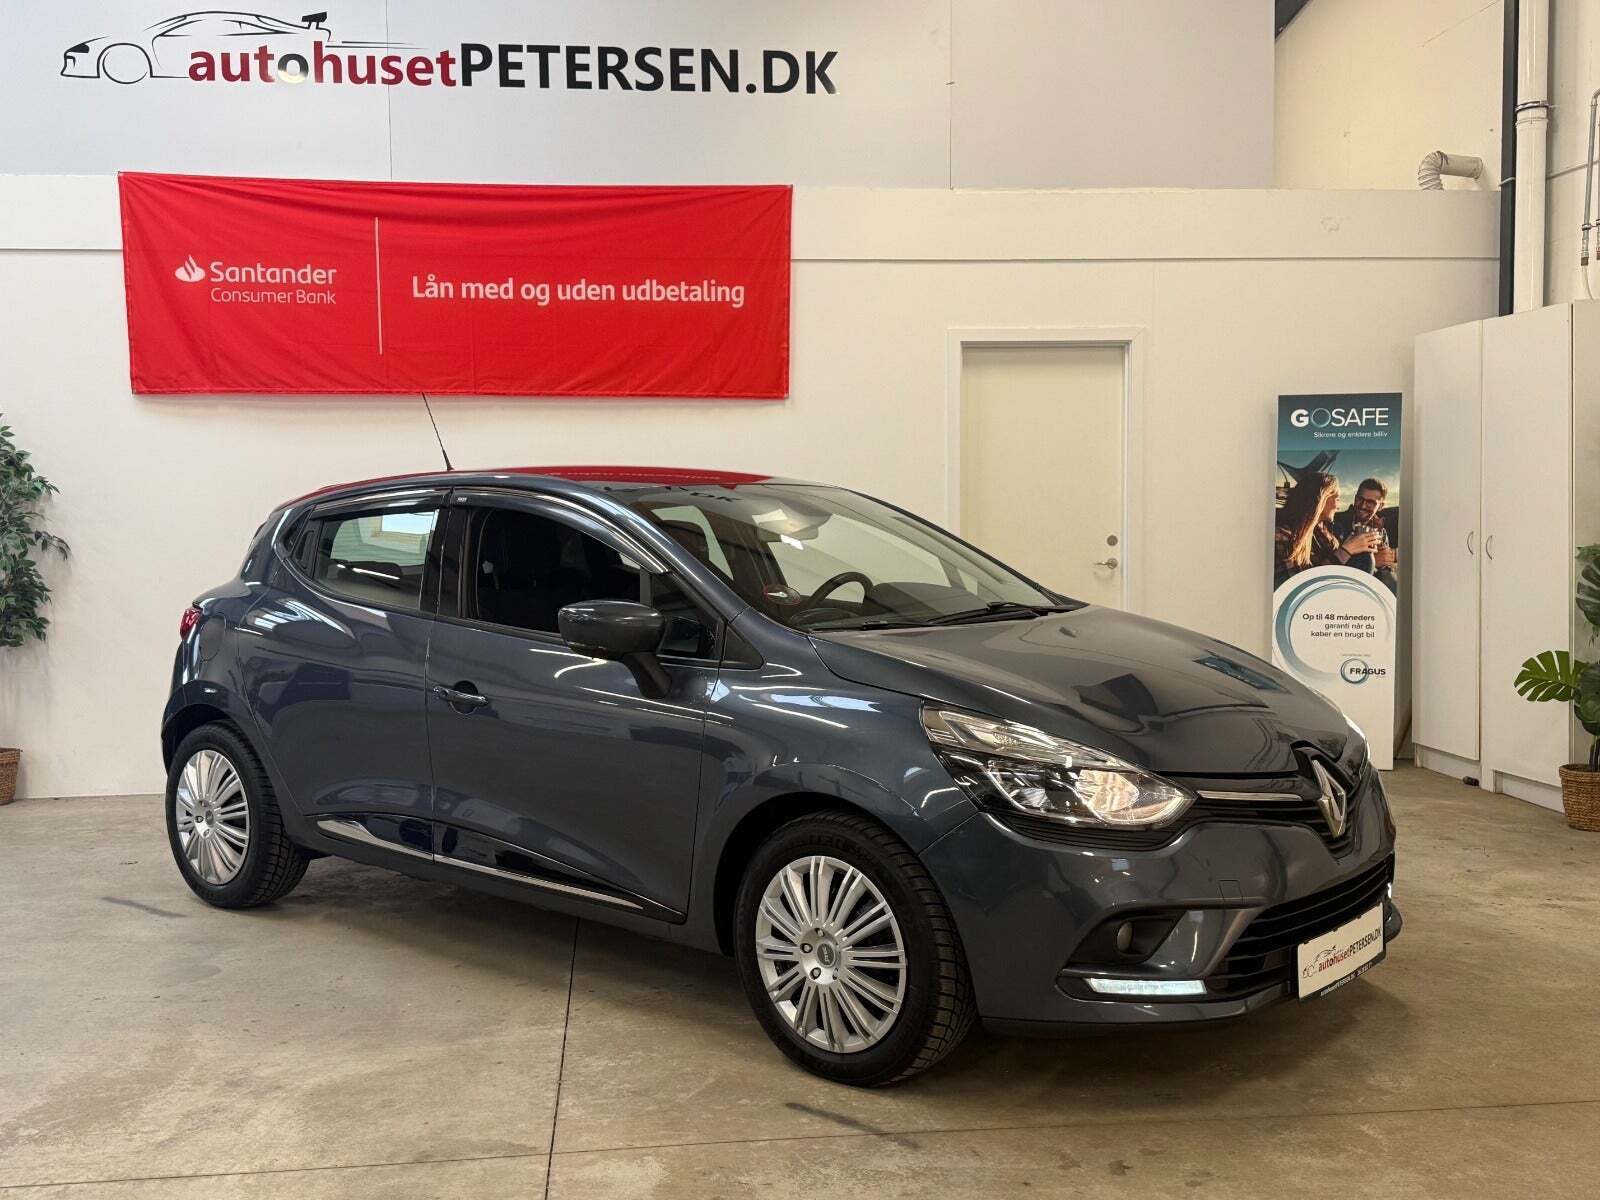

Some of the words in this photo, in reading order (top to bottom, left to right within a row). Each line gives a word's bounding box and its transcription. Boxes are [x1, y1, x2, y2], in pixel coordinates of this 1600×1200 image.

[210, 261, 337, 285] Santander
[210, 287, 294, 304] Consumer
[296, 289, 337, 305] Bank
[412, 274, 454, 299] Lån
[461, 277, 514, 300] med
[520, 282, 550, 306] og
[557, 278, 615, 301] uden
[622, 279, 745, 308] udbetaling
[1290, 407, 1389, 428] GOSAFE
[1302, 613, 1314, 622] Op
[1336, 613, 1375, 621] måneders
[1351, 622, 1364, 630] når
[1344, 631, 1364, 639] brugt
[1349, 667, 1386, 675] FRAGUS
